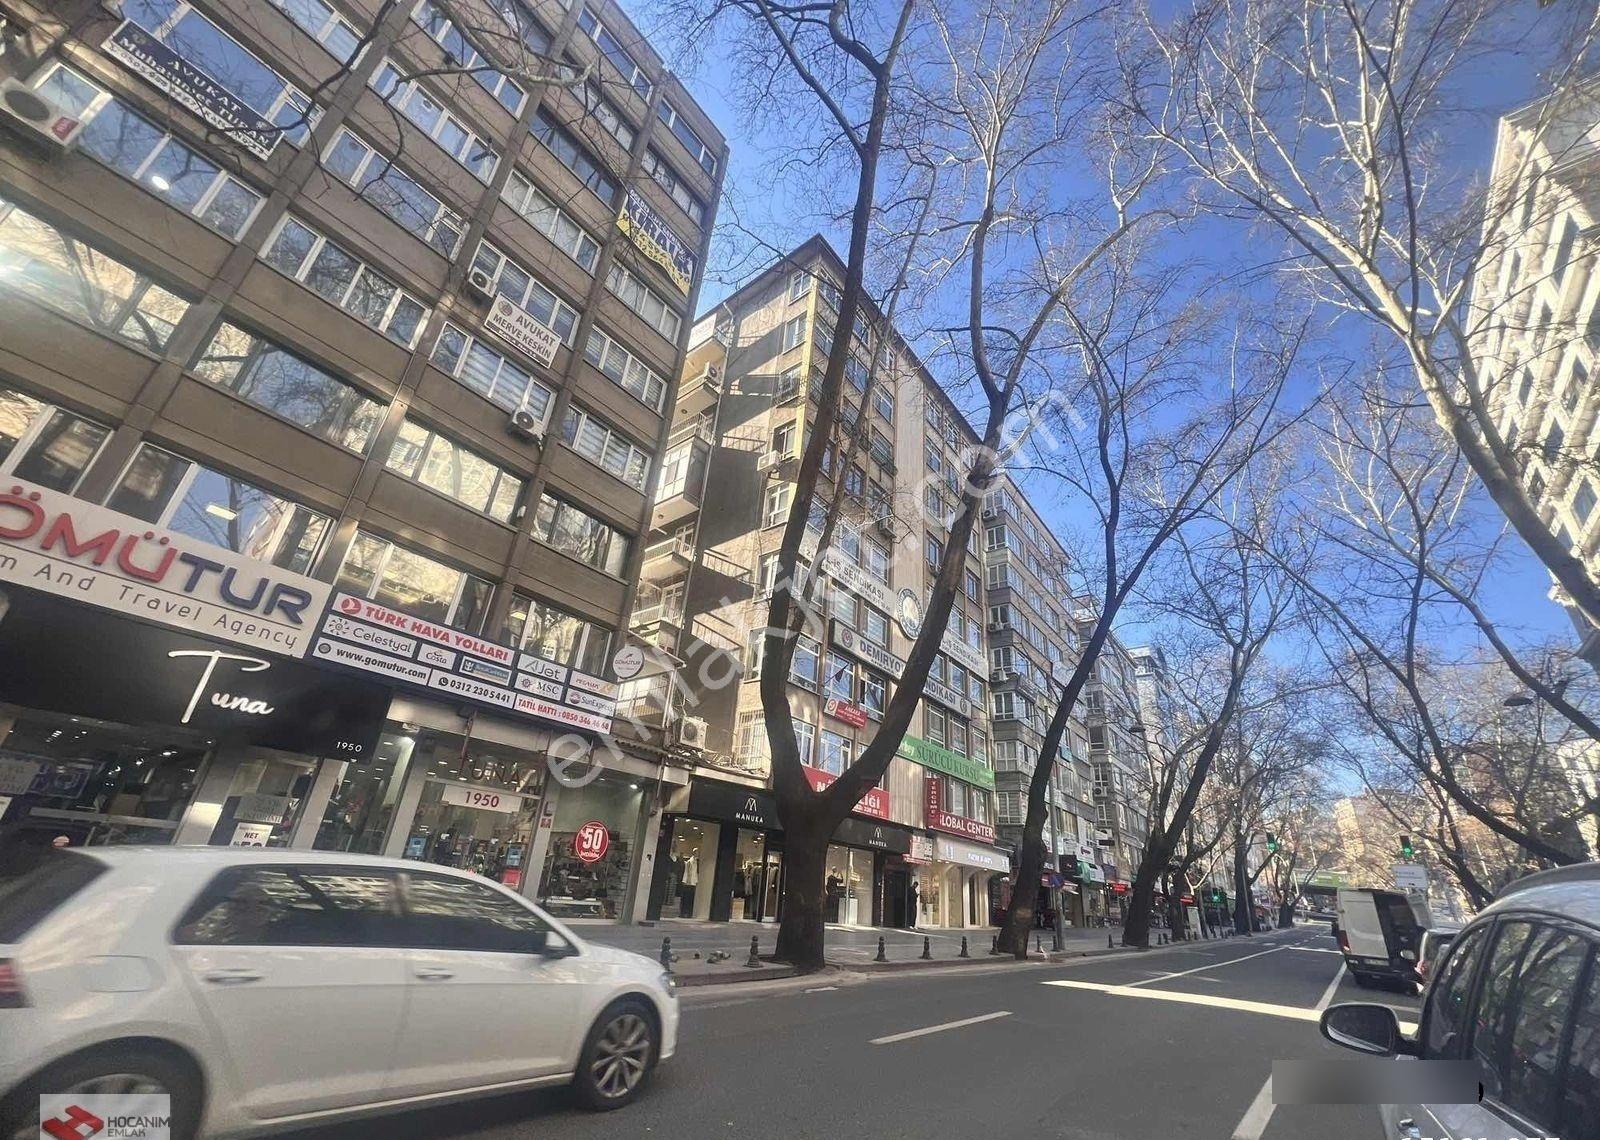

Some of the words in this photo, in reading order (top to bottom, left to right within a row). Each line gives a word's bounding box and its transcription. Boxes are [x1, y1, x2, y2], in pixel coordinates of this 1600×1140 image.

[168, 58, 243, 114] AVUKAT
[492, 314, 523, 338] MERVE
[522, 334, 552, 360] KESKİN
[516, 314, 555, 346] AVUKAT
[34, 561, 95, 591] And
[118, 584, 201, 621] Travel
[213, 612, 298, 650] Agency
[352, 626, 412, 654] Celestyal
[366, 606, 408, 630] TÜRK
[410, 622, 450, 643] HAVA
[454, 636, 509, 662] YOLLARI
[336, 648, 427, 681] www.gomutur.com
[425, 650, 448, 665] Costa
[168, 650, 274, 723] Tuna
[450, 680, 472, 693] 0312
[536, 680, 560, 695] MSC
[561, 708, 578, 725] 0850
[336, 741, 362, 752] 1950
[464, 791, 500, 808] 1950
[735, 812, 764, 824] MANUKA
[940, 813, 966, 832] LOBAL
[967, 821, 994, 838] CENTER
[243, 832, 259, 840] NET
